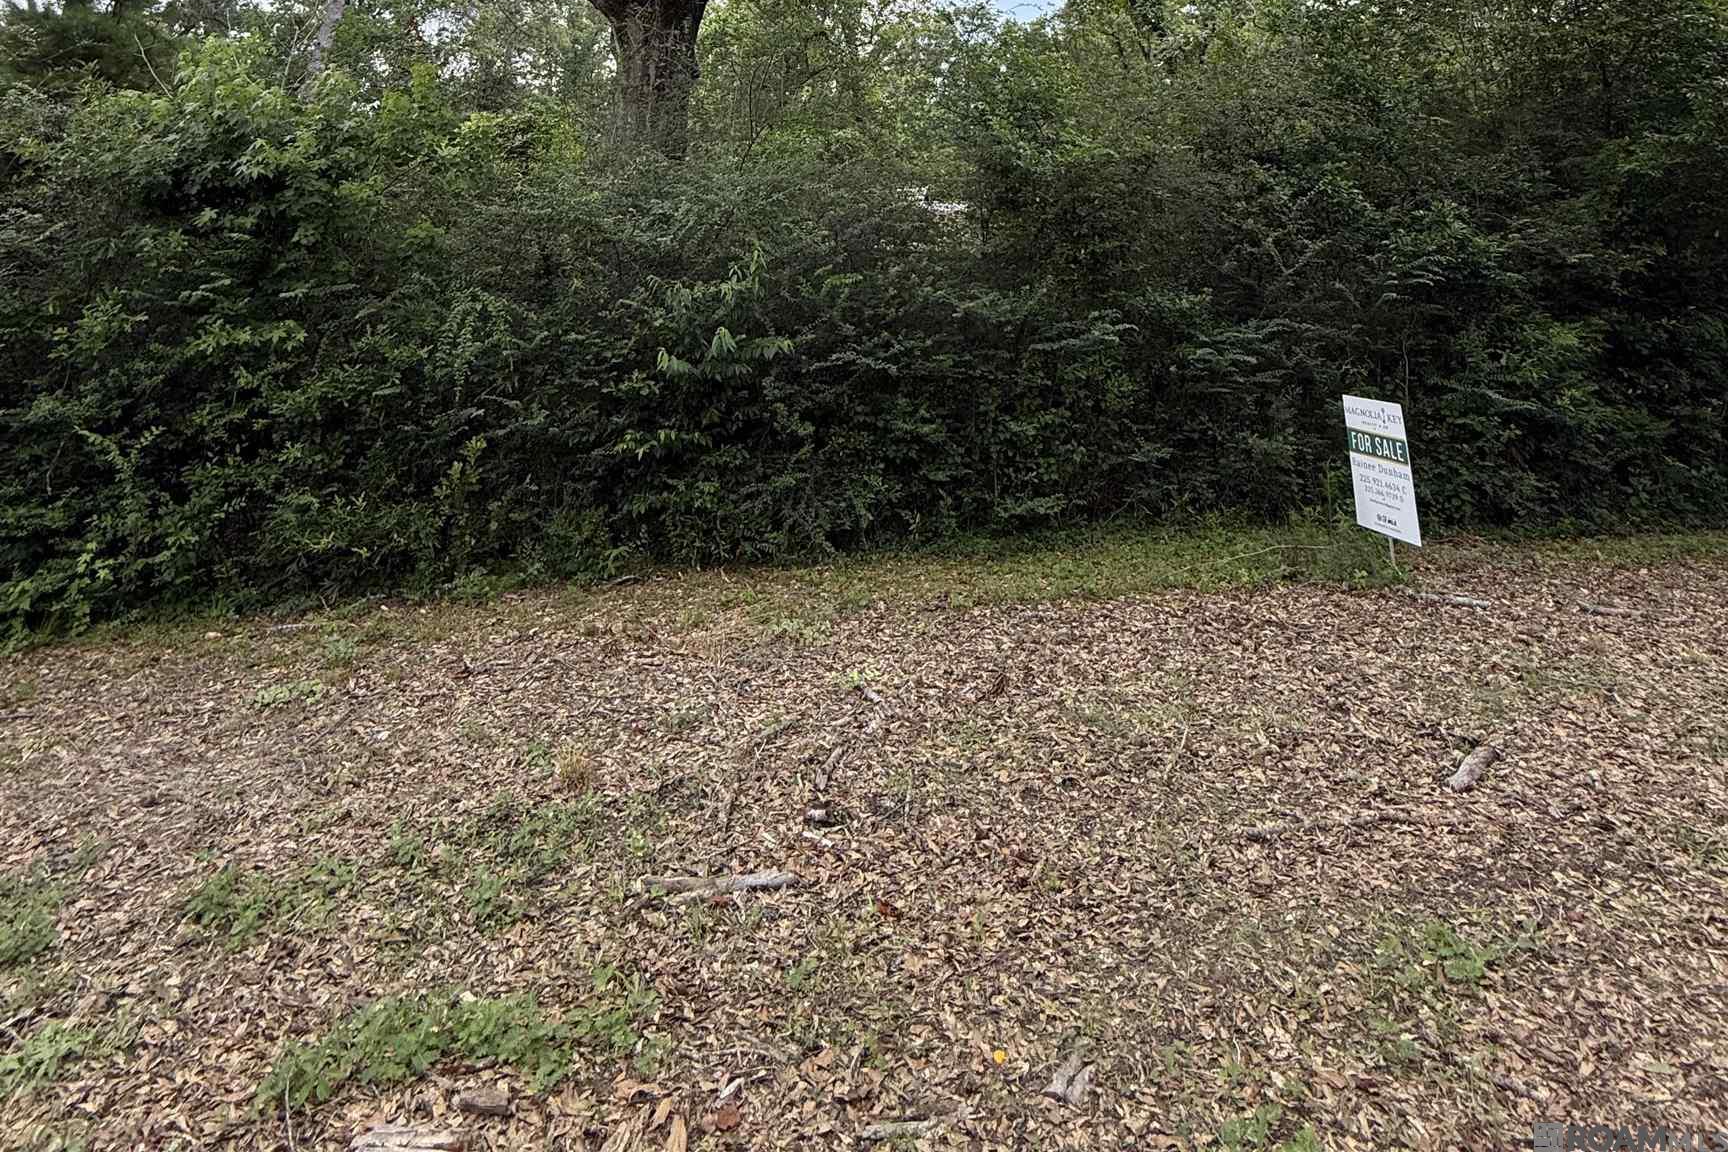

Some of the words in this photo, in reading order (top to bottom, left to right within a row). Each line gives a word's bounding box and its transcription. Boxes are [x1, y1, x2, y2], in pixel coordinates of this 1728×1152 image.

[1344, 407, 1381, 420] MAGNOLIA
[1387, 414, 1402, 425] KEY
[1351, 431, 1372, 453] FOR
[1375, 437, 1404, 462] SALE
